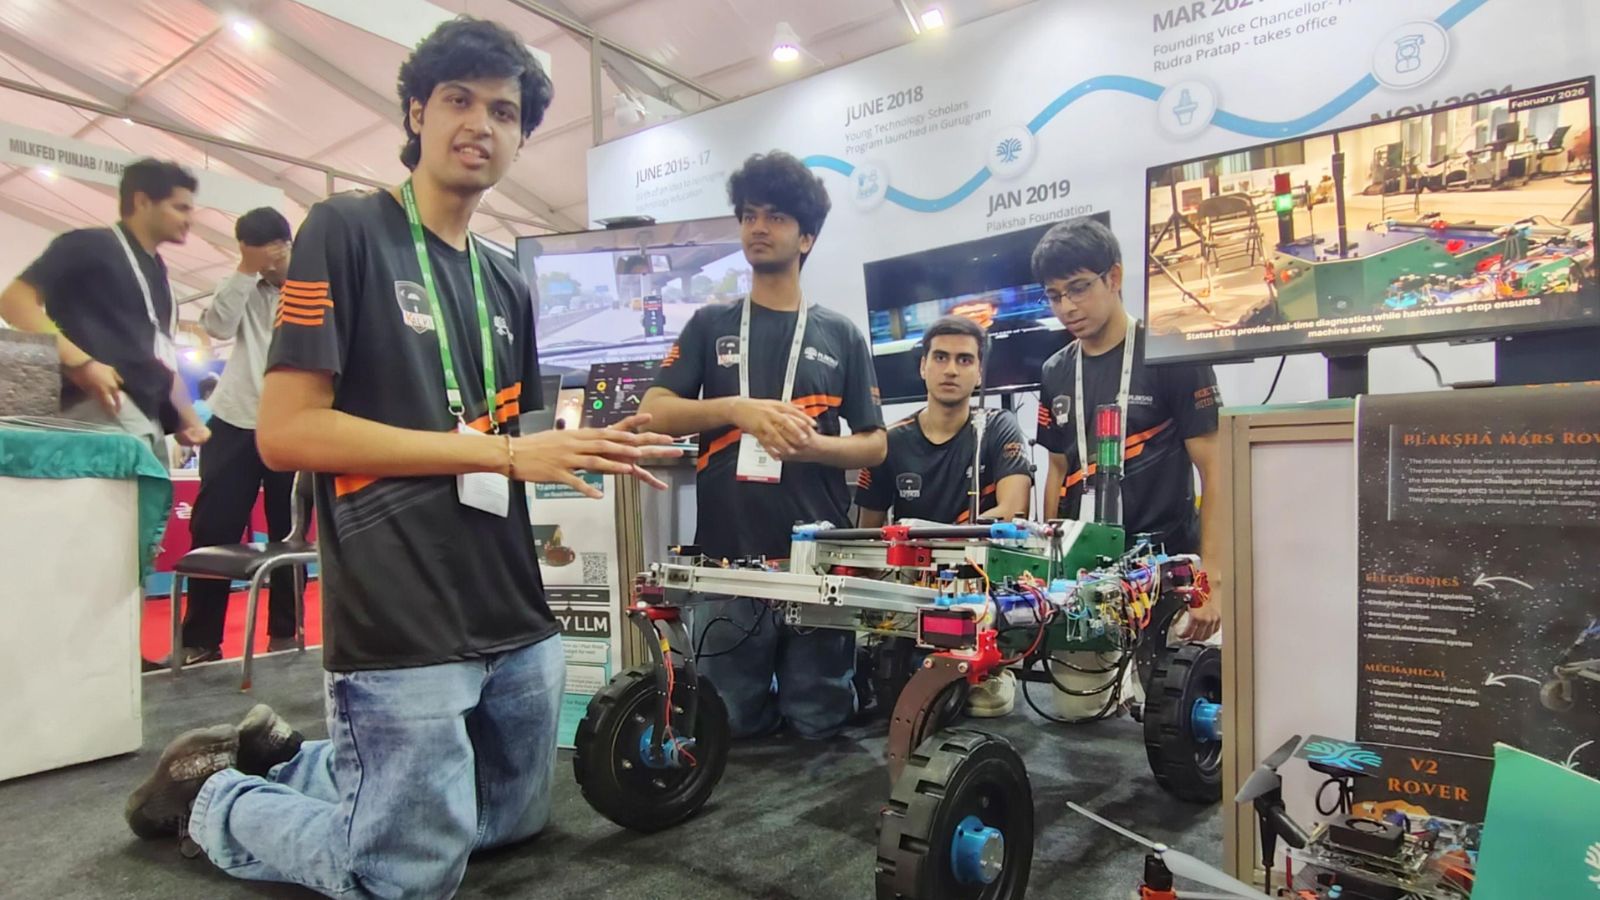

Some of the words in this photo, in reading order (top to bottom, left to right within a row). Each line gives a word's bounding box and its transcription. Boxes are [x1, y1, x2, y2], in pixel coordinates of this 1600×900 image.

[1153, 2, 1206, 32] MAR
[1153, 31, 1214, 56] Founding
[1217, 22, 1245, 38] Vice
[1153, 53, 1192, 72] Rudra
[1196, 41, 1241, 60] Pratap
[1253, 27, 1291, 46] takes
[1296, 15, 1337, 34] office
[845, 97, 884, 127] JUNE
[887, 85, 924, 111] 2018
[1511, 94, 1556, 109] February
[1557, 87, 1585, 99] 2026
[845, 128, 873, 142] Young
[874, 113, 925, 135] Technology
[928, 100, 969, 120] Scholars
[845, 138, 883, 155] Program
[885, 126, 927, 145] launched
[928, 122, 938, 133] in
[940, 108, 992, 129] Gurugram
[9, 138, 55, 161] MILKFED
[58, 149, 96, 170] PUNJAB
[636, 164, 663, 188] JUNE
[665, 157, 690, 176] 2015
[699, 150, 711, 166] 17
[986, 189, 1022, 218] JAN
[1026, 179, 1071, 205] 2019
[986, 215, 1026, 232] Plaksha
[1029, 204, 1093, 224] Foundation
[1186, 331, 1213, 341] Status
[1215, 329, 1236, 338] LEDs
[1237, 325, 1271, 336] provide
[1272, 320, 1314, 332] real-time
[1315, 314, 1372, 329] diagnostics
[1374, 309, 1402, 321] while
[1403, 306, 1453, 319] hardware
[1455, 301, 1492, 314] e-stop
[1493, 297, 1541, 309] ensures
[1308, 328, 1349, 338] machine
[1403, 432, 1493, 447] PLAKSHA
[1500, 432, 1554, 447] MARS
[1366, 573, 1460, 587] ELECTRONICS
[574, 616, 608, 632] LLM
[1364, 663, 1446, 678] MECHANICAL
[1410, 757, 1439, 775] V2
[1387, 777, 1470, 802] ROVER
